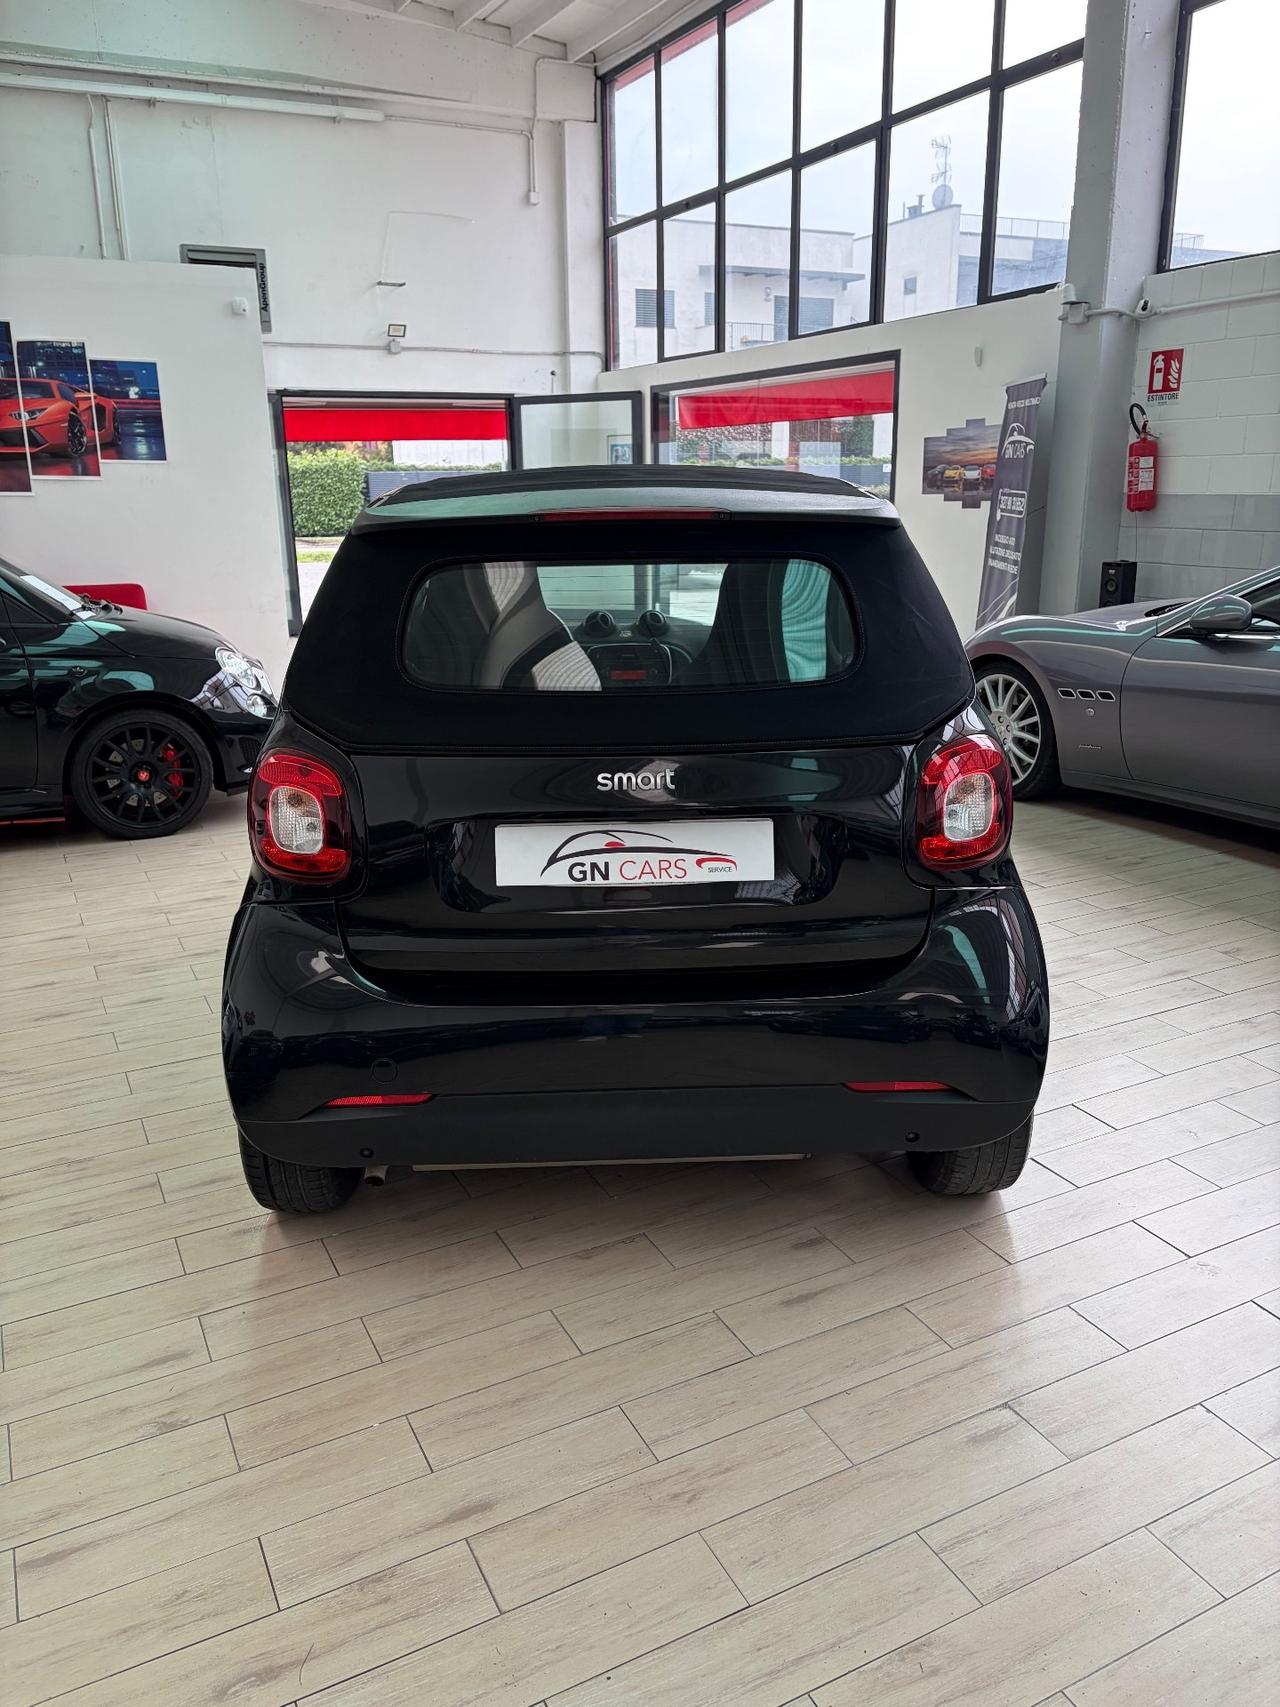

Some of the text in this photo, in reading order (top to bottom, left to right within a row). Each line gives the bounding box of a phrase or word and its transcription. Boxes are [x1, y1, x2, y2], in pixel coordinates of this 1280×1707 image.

[1147, 392, 1180, 402] ESTINTORE
[596, 768, 676, 792] smart
[567, 858, 688, 883] GN CARS
[707, 865, 733, 873] SERVICE
